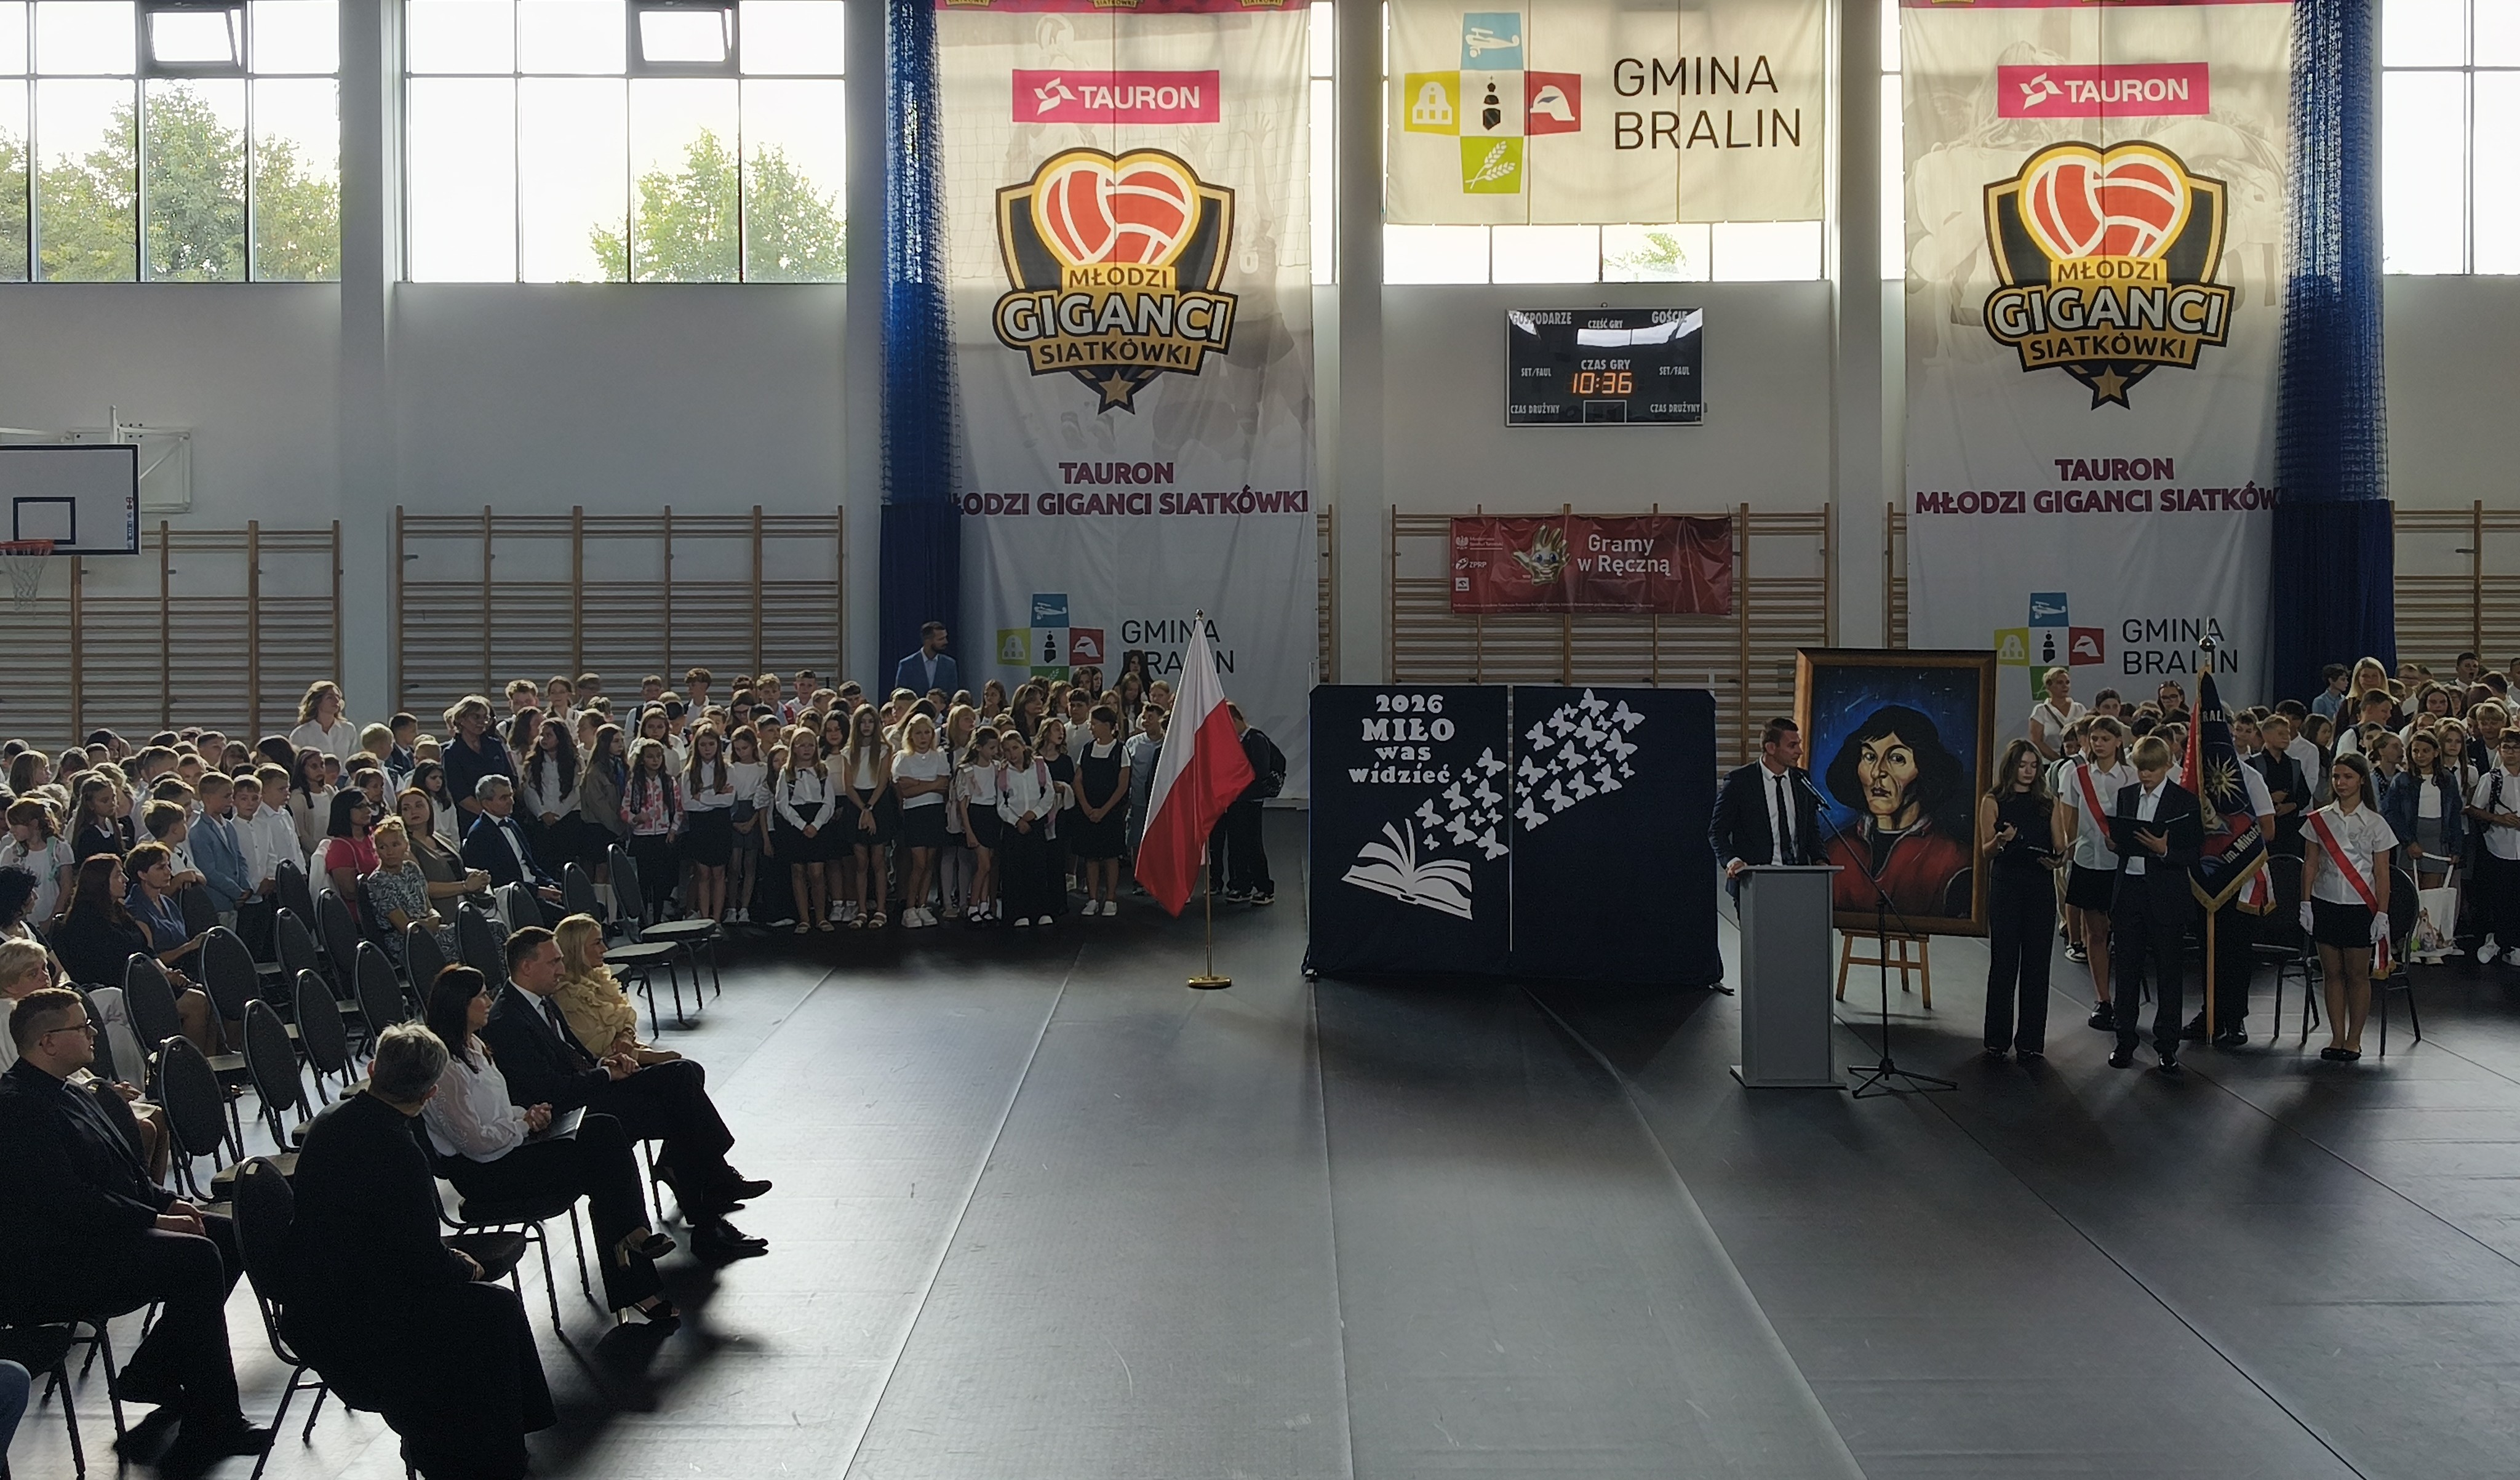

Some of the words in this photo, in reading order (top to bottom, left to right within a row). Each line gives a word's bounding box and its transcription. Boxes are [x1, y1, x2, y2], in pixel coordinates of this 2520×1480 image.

[1614, 55, 1779, 97] GMINA
[1078, 86, 1200, 109] TAURON
[2064, 78, 2188, 103] TAURON
[1614, 108, 1800, 150] BRALIN
[1069, 267, 1168, 289] MŁODZI
[2057, 260, 2159, 282] MŁODZI
[1002, 293, 1227, 343] GIGANCI
[1512, 312, 1572, 325] GOSPODARZE
[1588, 318, 1608, 329] CZĘŚĆ
[1609, 319, 1624, 329] GRY
[1651, 308, 1688, 324] GOŚCIE
[1992, 287, 2223, 338] GIGANCI
[1039, 338, 1192, 366] SIATKÓWKI
[2030, 332, 2186, 361] SIATKÓWKI
[1521, 367, 1552, 377] SET/FAUL
[1581, 359, 1606, 370] CZAS
[1609, 359, 1631, 370] GRY
[1659, 366, 1690, 375] SET/FAUL
[1573, 372, 1632, 394] 10:36
[1510, 404, 1526, 414] CZAS
[1528, 402, 1560, 414] DRUŻYNY
[1650, 404, 1667, 413] CZAS
[1669, 401, 1701, 413] DRUŻYNY
[1058, 462, 1174, 485] TAURON
[2054, 458, 2174, 481] TAURON
[1037, 493, 1152, 515] GIGANCI
[1158, 484, 1308, 516] SIATKÓWKI
[1915, 490, 2026, 514] MŁODZI
[2033, 489, 2153, 513] GIGANCI
[1589, 534, 1654, 556] Gramy
[1577, 558, 1592, 572] w
[1598, 554, 1672, 577] Ręczną
[1122, 620, 1221, 644] GMINA
[2123, 618, 2225, 643] GMINA
[1123, 650, 1234, 674] RAN
[2123, 649, 2238, 674] BRALIN
[1376, 694, 1444, 714] 2026
[2203, 710, 2226, 722] RALI
[1362, 718, 1455, 742] MIŁO
[1374, 746, 1432, 761] was
[1348, 761, 1451, 783] widzieć
